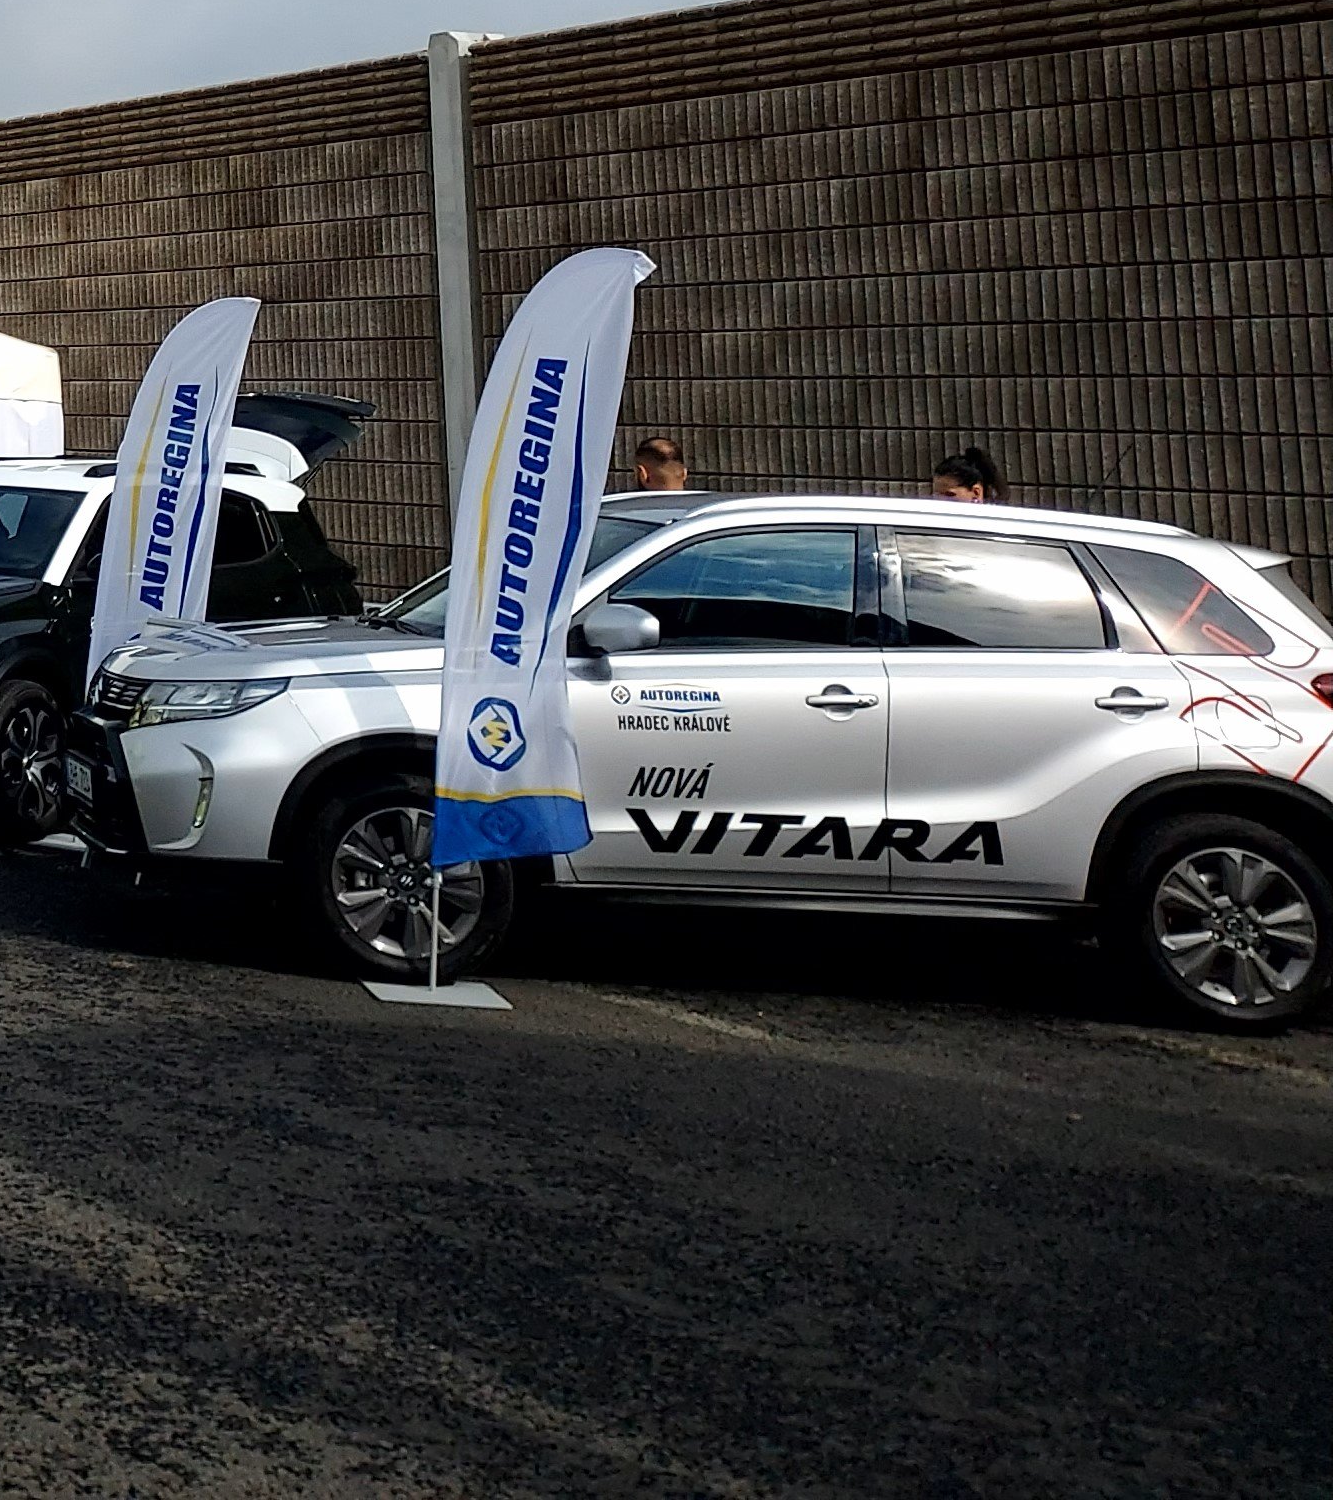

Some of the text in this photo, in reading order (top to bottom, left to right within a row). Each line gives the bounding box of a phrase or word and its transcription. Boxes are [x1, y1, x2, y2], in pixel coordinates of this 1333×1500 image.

[139, 384, 201, 612] AUTOREGINA
[490, 358, 568, 668] AUTOREGINA
[639, 689, 721, 702] AUTOREGINA
[618, 713, 731, 732] HRADEC KRÁLOVÉ
[628, 762, 715, 799] NOVÁ
[625, 807, 1004, 866] VITARA
